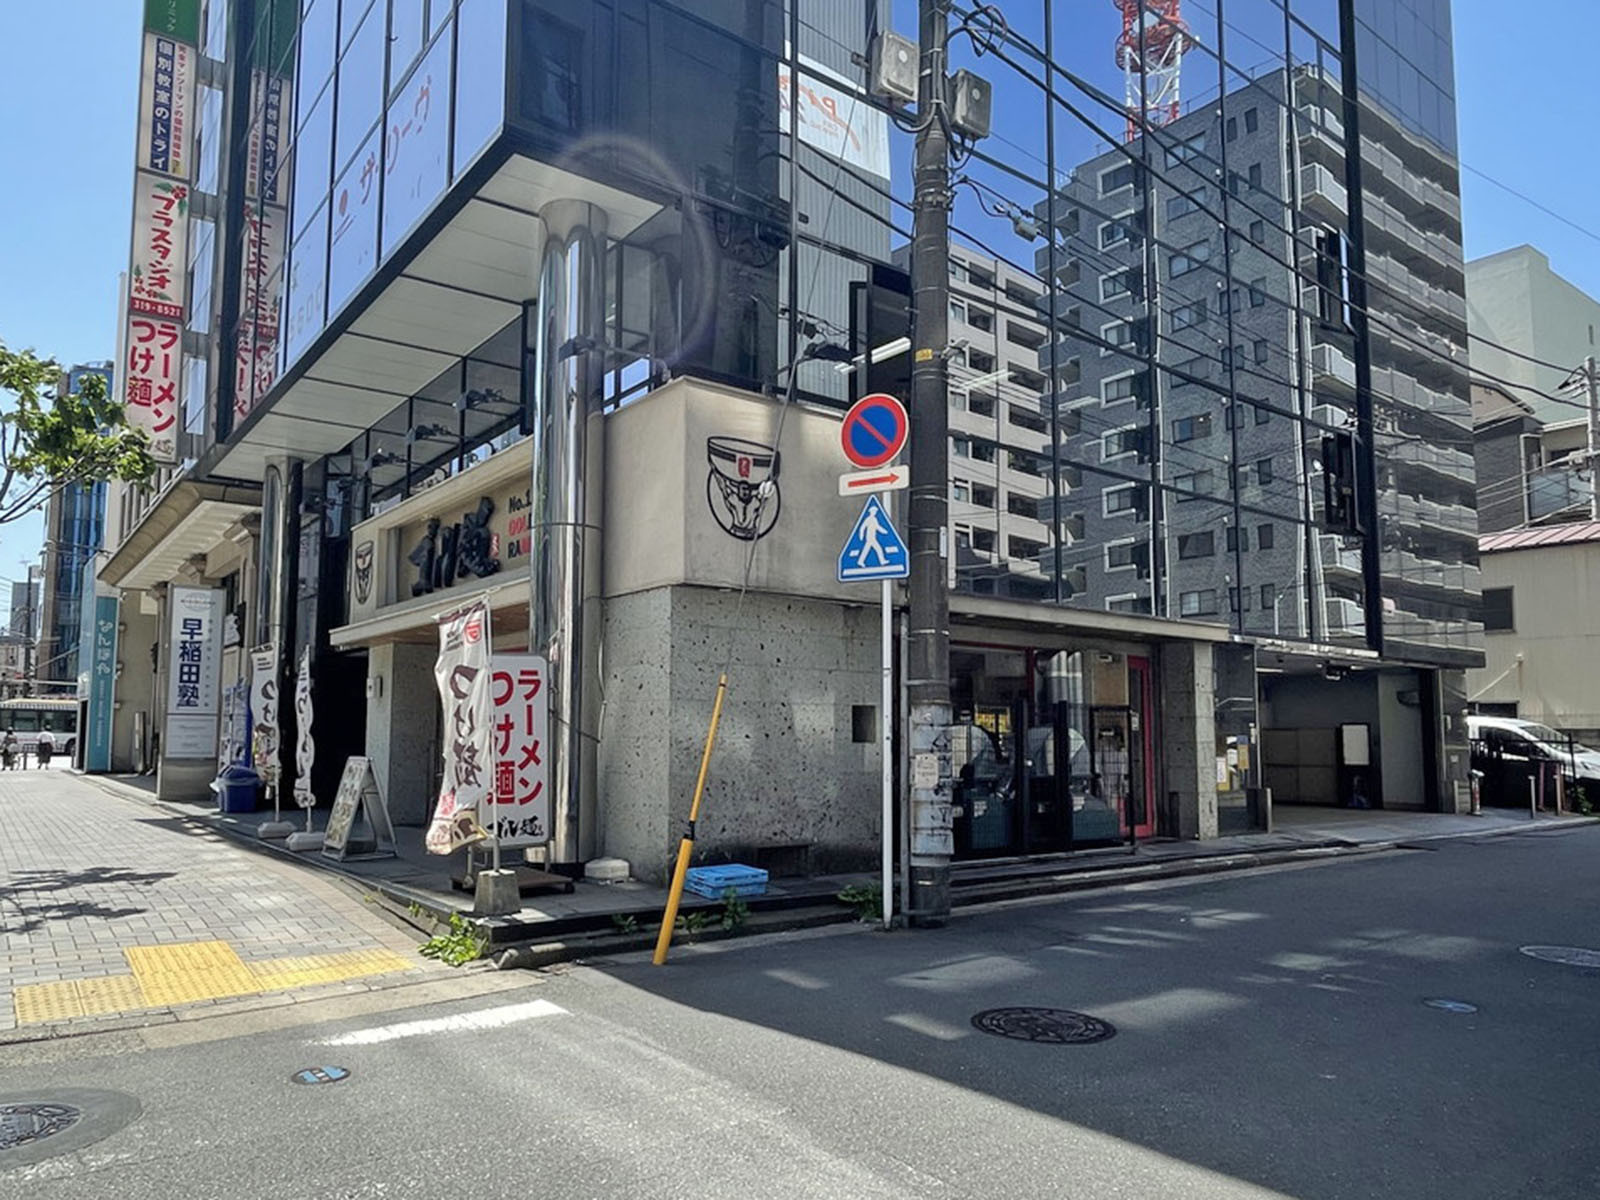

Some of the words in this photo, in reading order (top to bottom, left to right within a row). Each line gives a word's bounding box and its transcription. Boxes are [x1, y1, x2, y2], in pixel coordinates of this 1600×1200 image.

[127, 320, 156, 407] つけ麺
[153, 323, 178, 433] ラーメン
[177, 618, 203, 707] 早稲田塾
[487, 671, 516, 806] つけ麺
[518, 669, 543, 806] ラーメン
